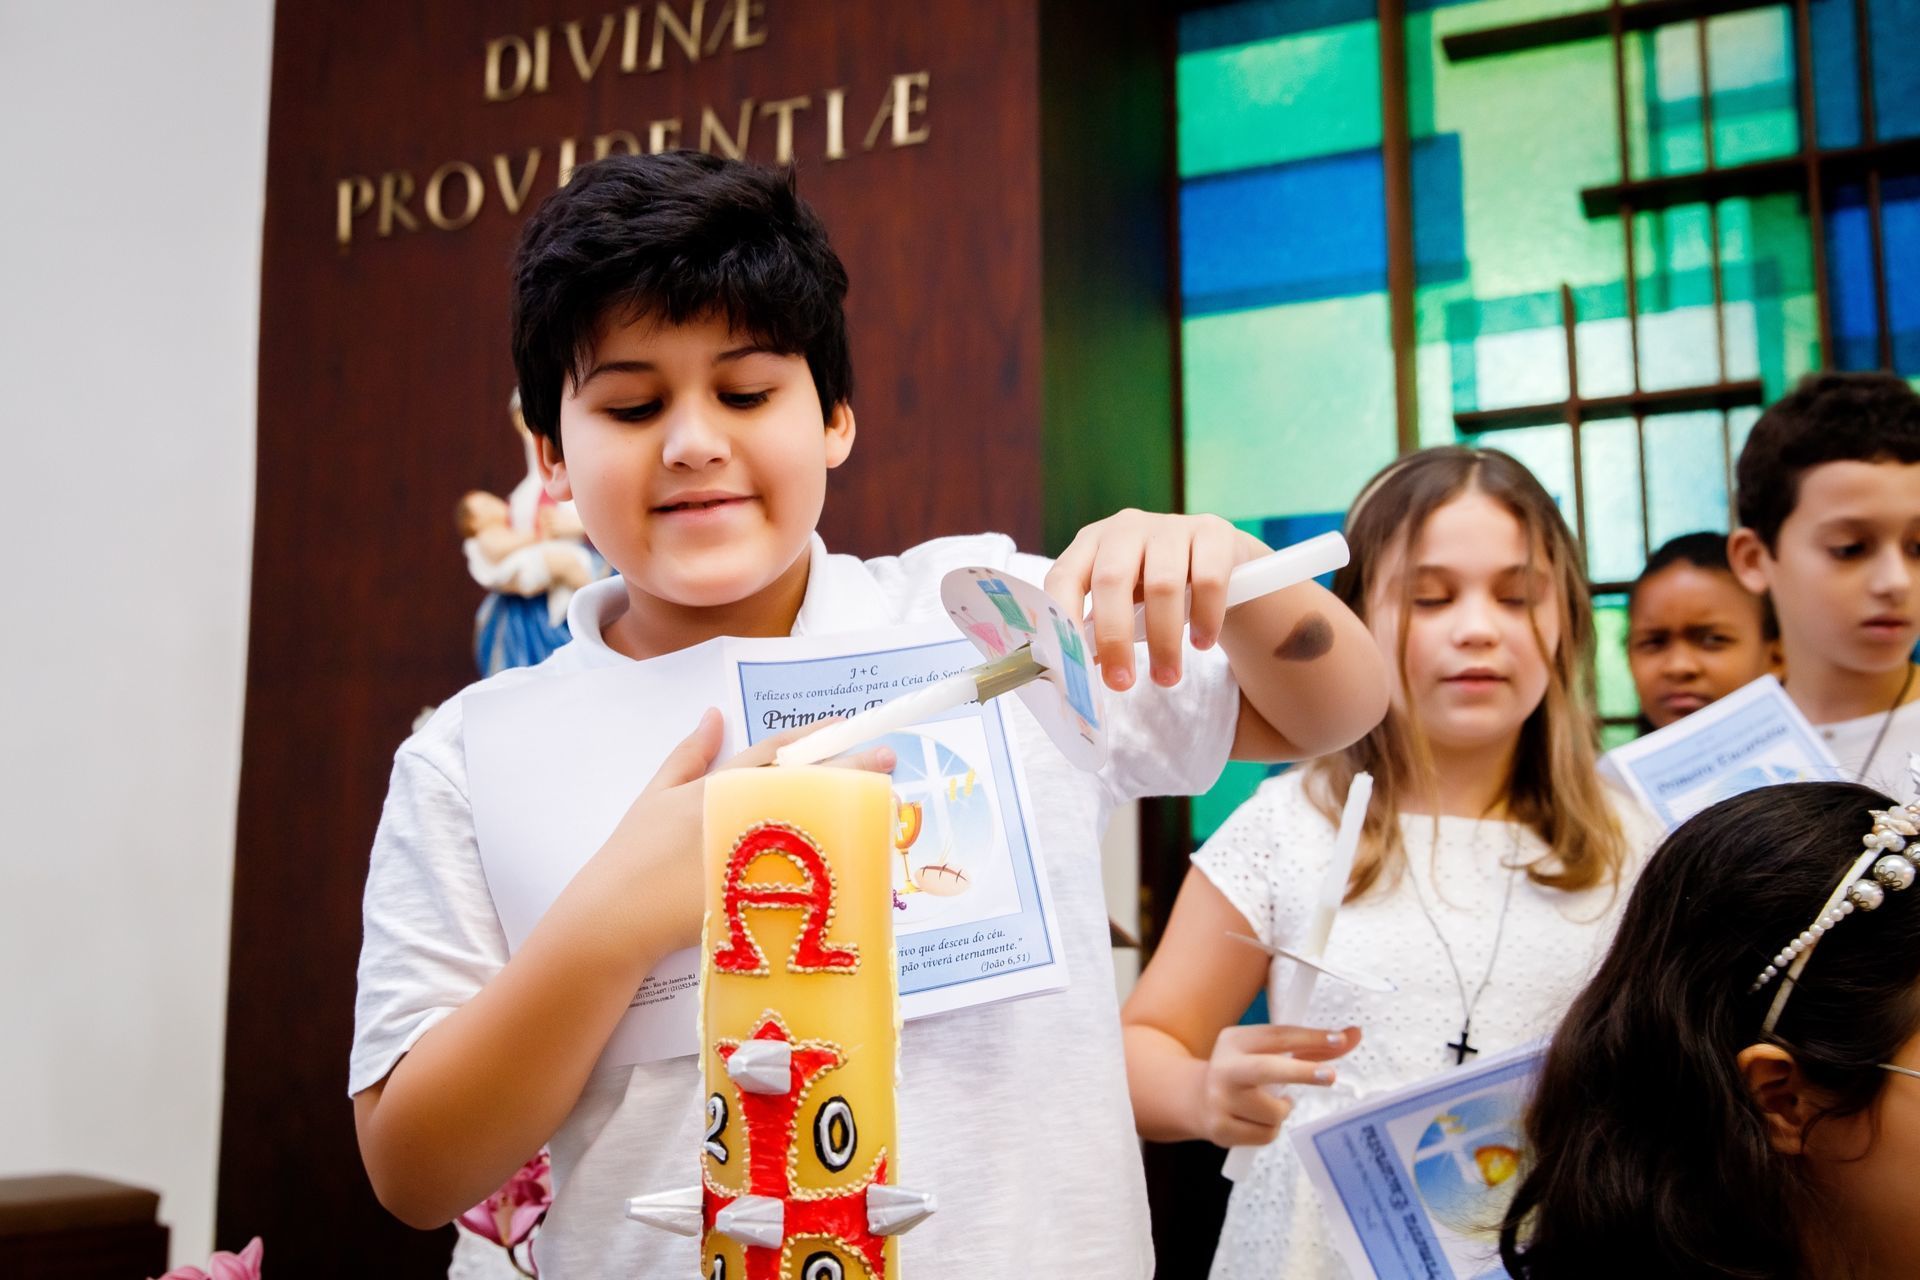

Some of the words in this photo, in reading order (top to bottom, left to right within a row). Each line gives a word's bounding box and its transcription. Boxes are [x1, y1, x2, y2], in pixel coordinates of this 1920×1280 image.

[870, 665, 879, 676] C
[753, 689, 790, 701] Felizes
[806, 682, 863, 698] convidados
[866, 681, 889, 694] para
[901, 676, 923, 687] Ceia
[926, 671, 939, 682] do
[918, 944, 936, 957] que
[938, 937, 969, 950] desceu
[972, 931, 985, 943] do
[987, 929, 1006, 940] céu.
[901, 961, 920, 976] pão
[922, 954, 952, 969] viverá
[981, 958, 1005, 973] (João
[1007, 952, 1031, 965] 6,51)
[813, 1096, 857, 1173] 0
